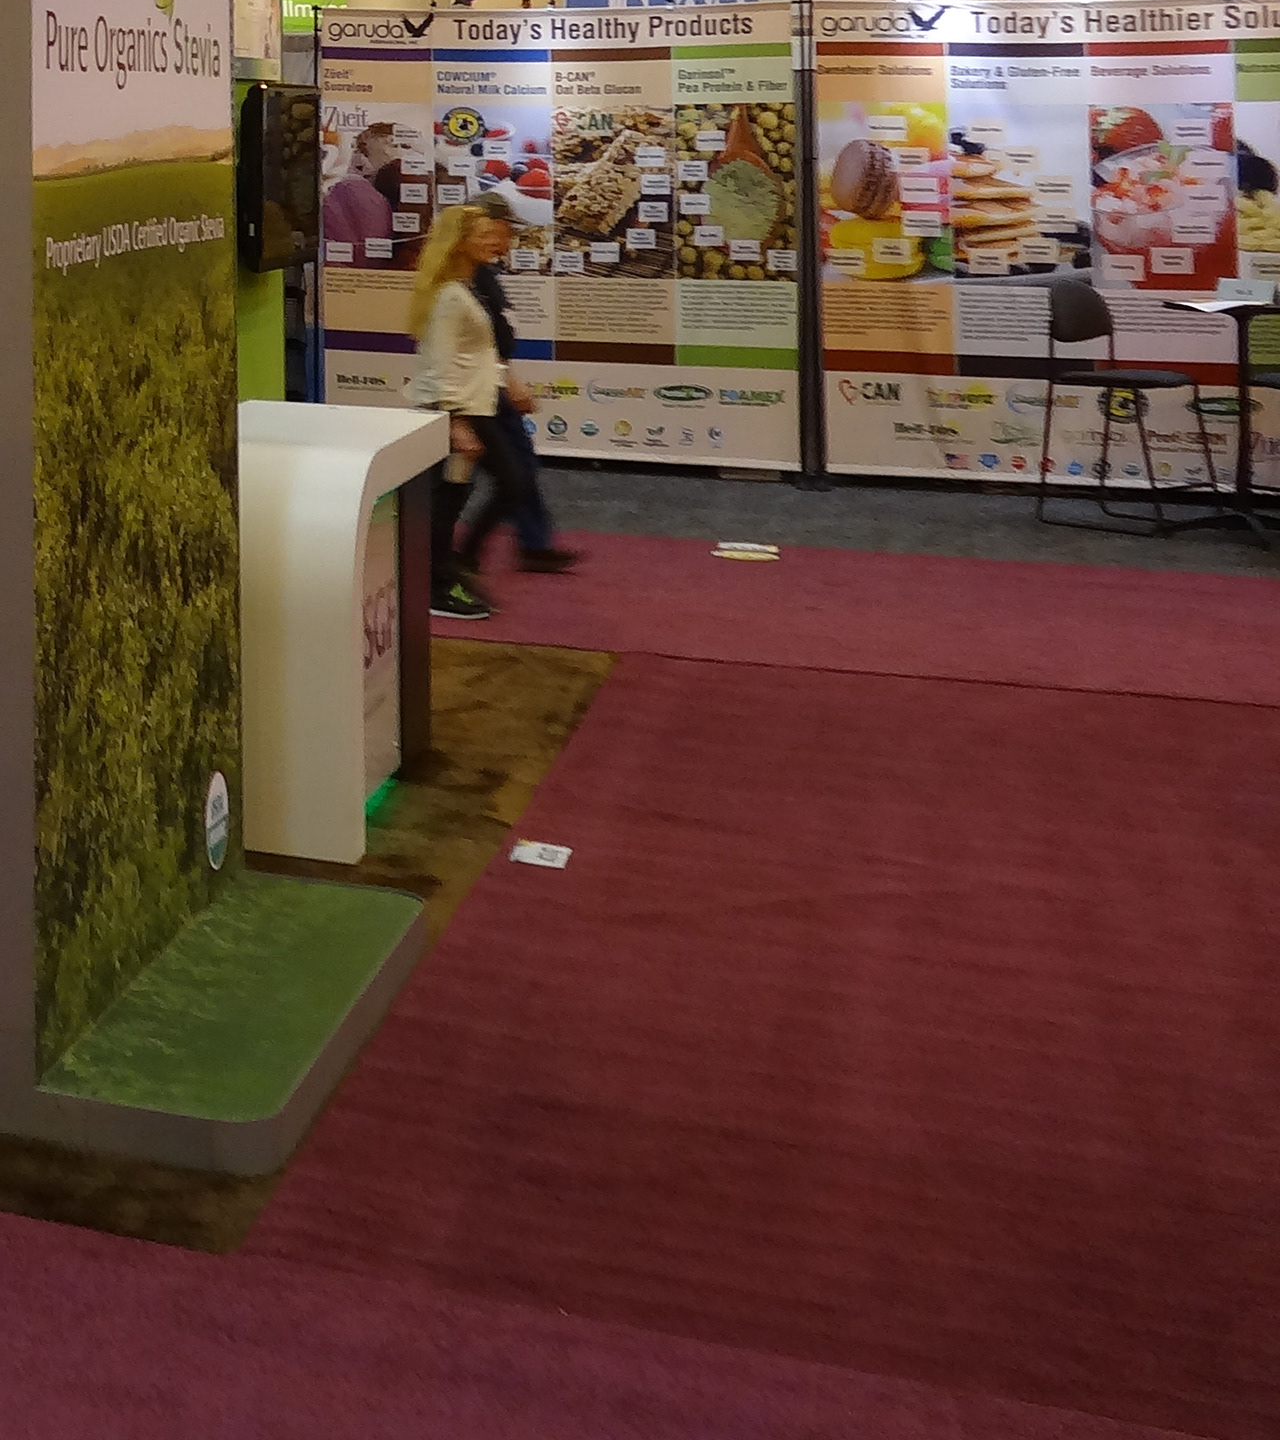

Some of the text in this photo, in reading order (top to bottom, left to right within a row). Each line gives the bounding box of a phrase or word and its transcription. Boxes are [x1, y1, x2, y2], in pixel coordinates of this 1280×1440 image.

[327, 20, 404, 42] garuda
[453, 13, 754, 45] Today's Healthy Products
[821, 14, 910, 37] garuda
[970, 10, 1075, 39] Today's
[1084, 7, 1215, 34] Healthier
[45, 10, 221, 90] Pure Organics Stevia
[323, 81, 373, 93] Sucralose
[437, 84, 548, 96] Natural Milk Calcium
[677, 81, 699, 94] Pea
[702, 81, 744, 93] Protein
[45, 212, 226, 277] Proprietary USDA Certified Organic Stevia
